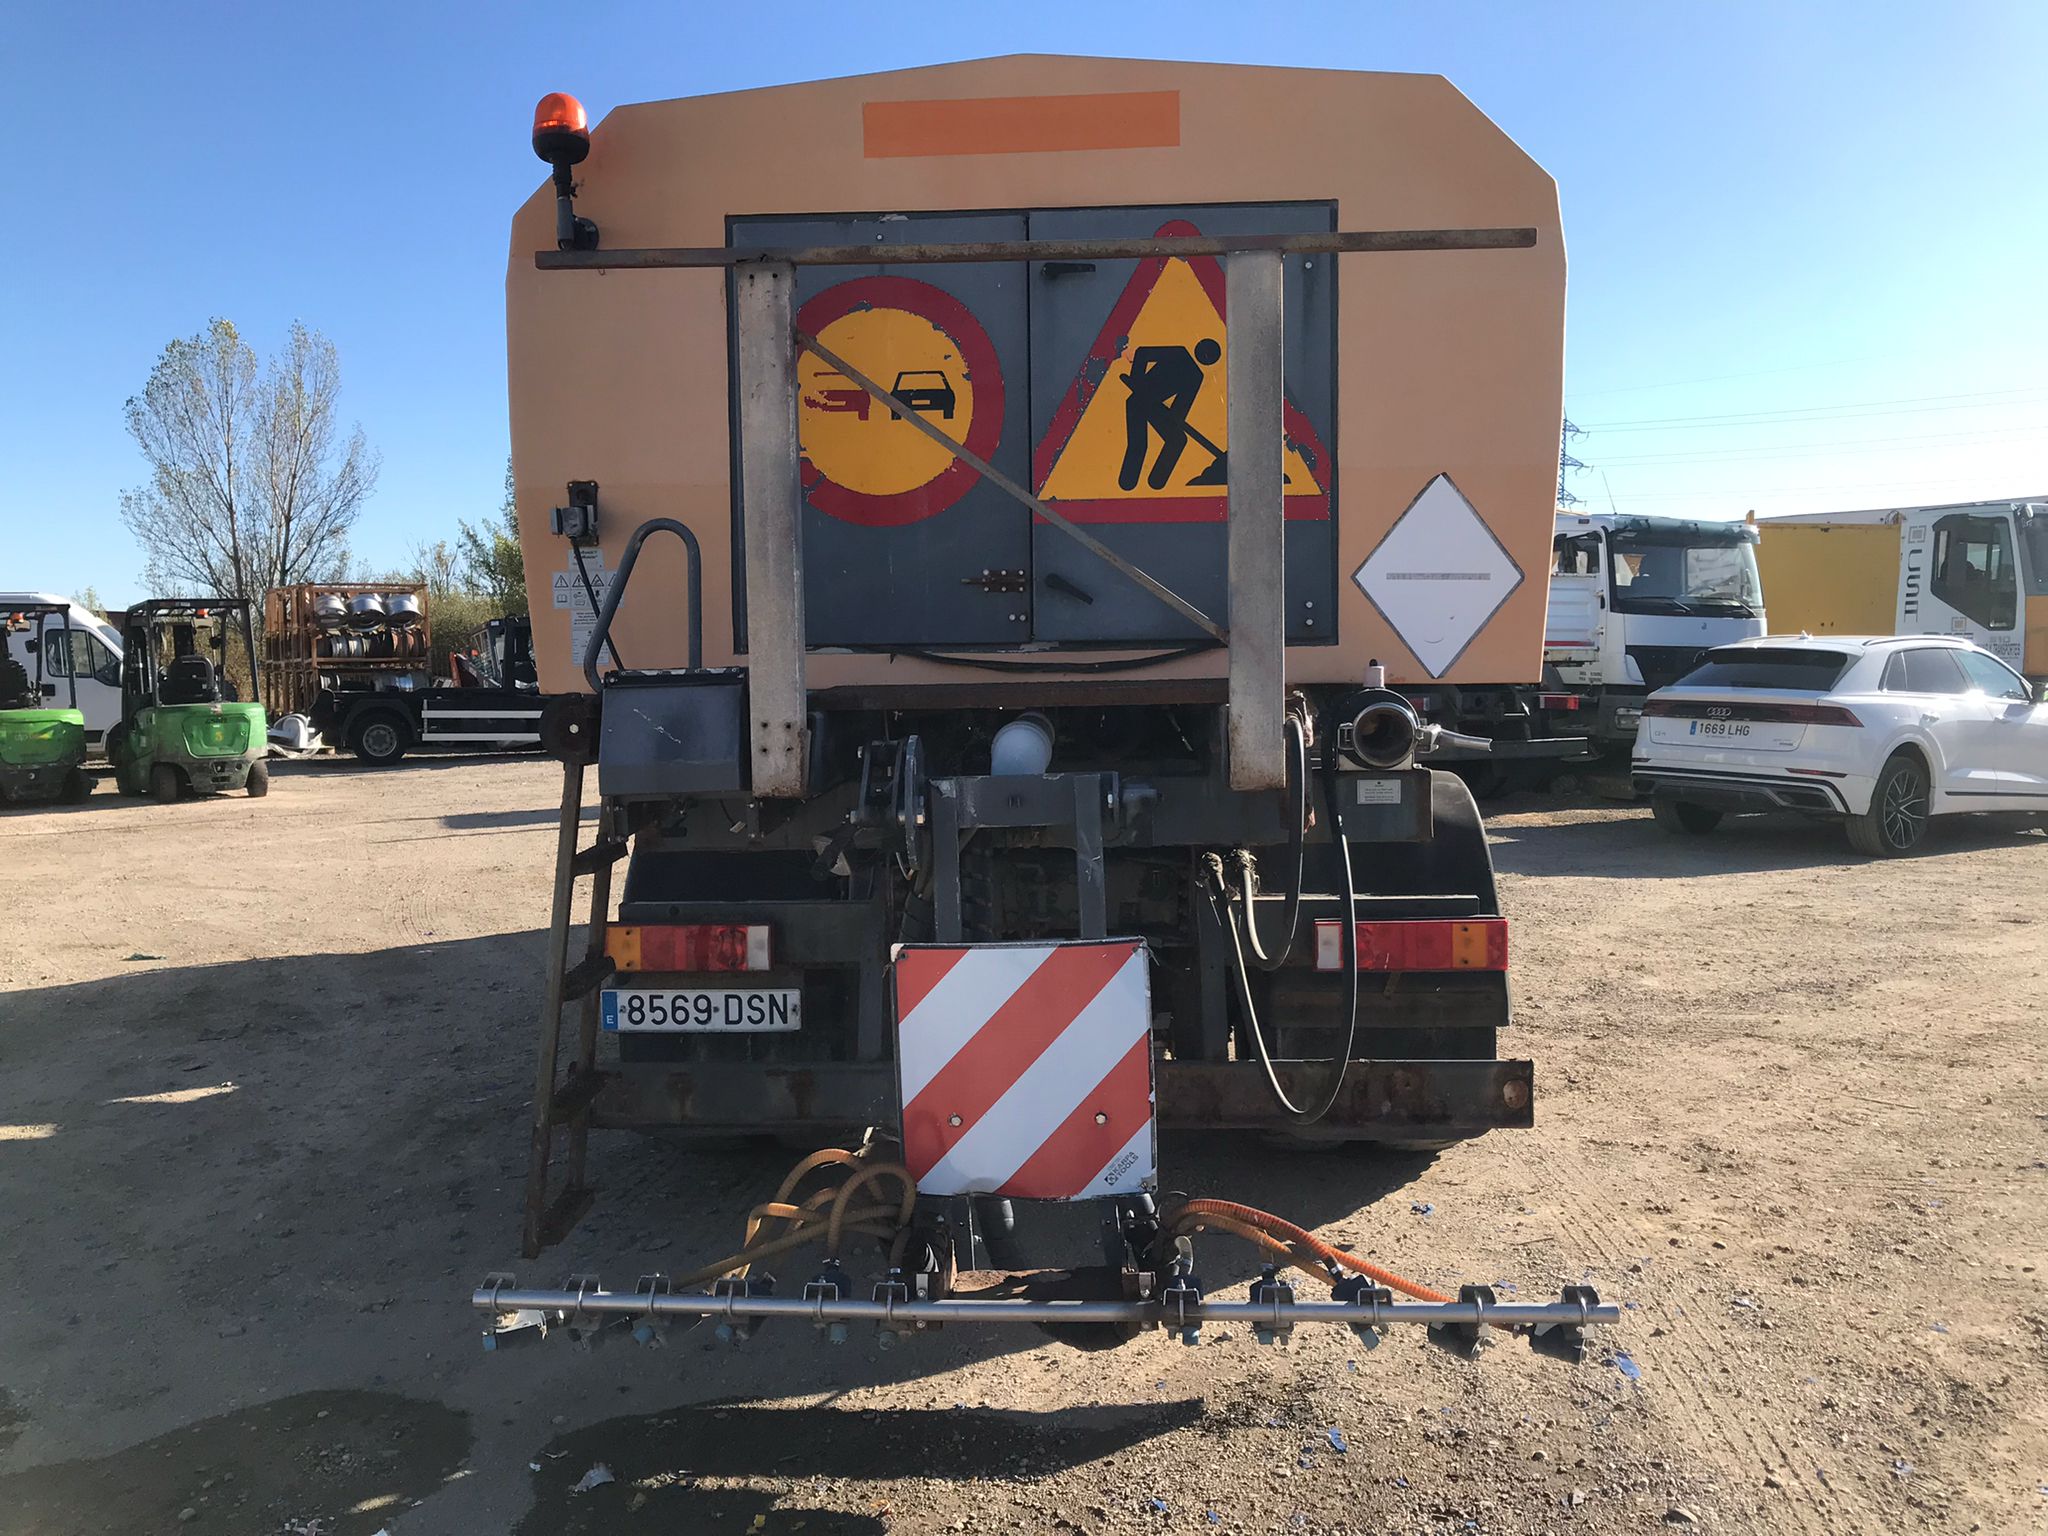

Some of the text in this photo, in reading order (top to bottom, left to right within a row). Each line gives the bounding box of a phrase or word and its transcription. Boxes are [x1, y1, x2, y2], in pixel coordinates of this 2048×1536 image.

[1699, 723, 1751, 737] 1669 LHG
[627, 993, 789, 1026] 8569 DSN
[606, 1014, 614, 1024] E
[1116, 1155, 1139, 1177] TOOLS
